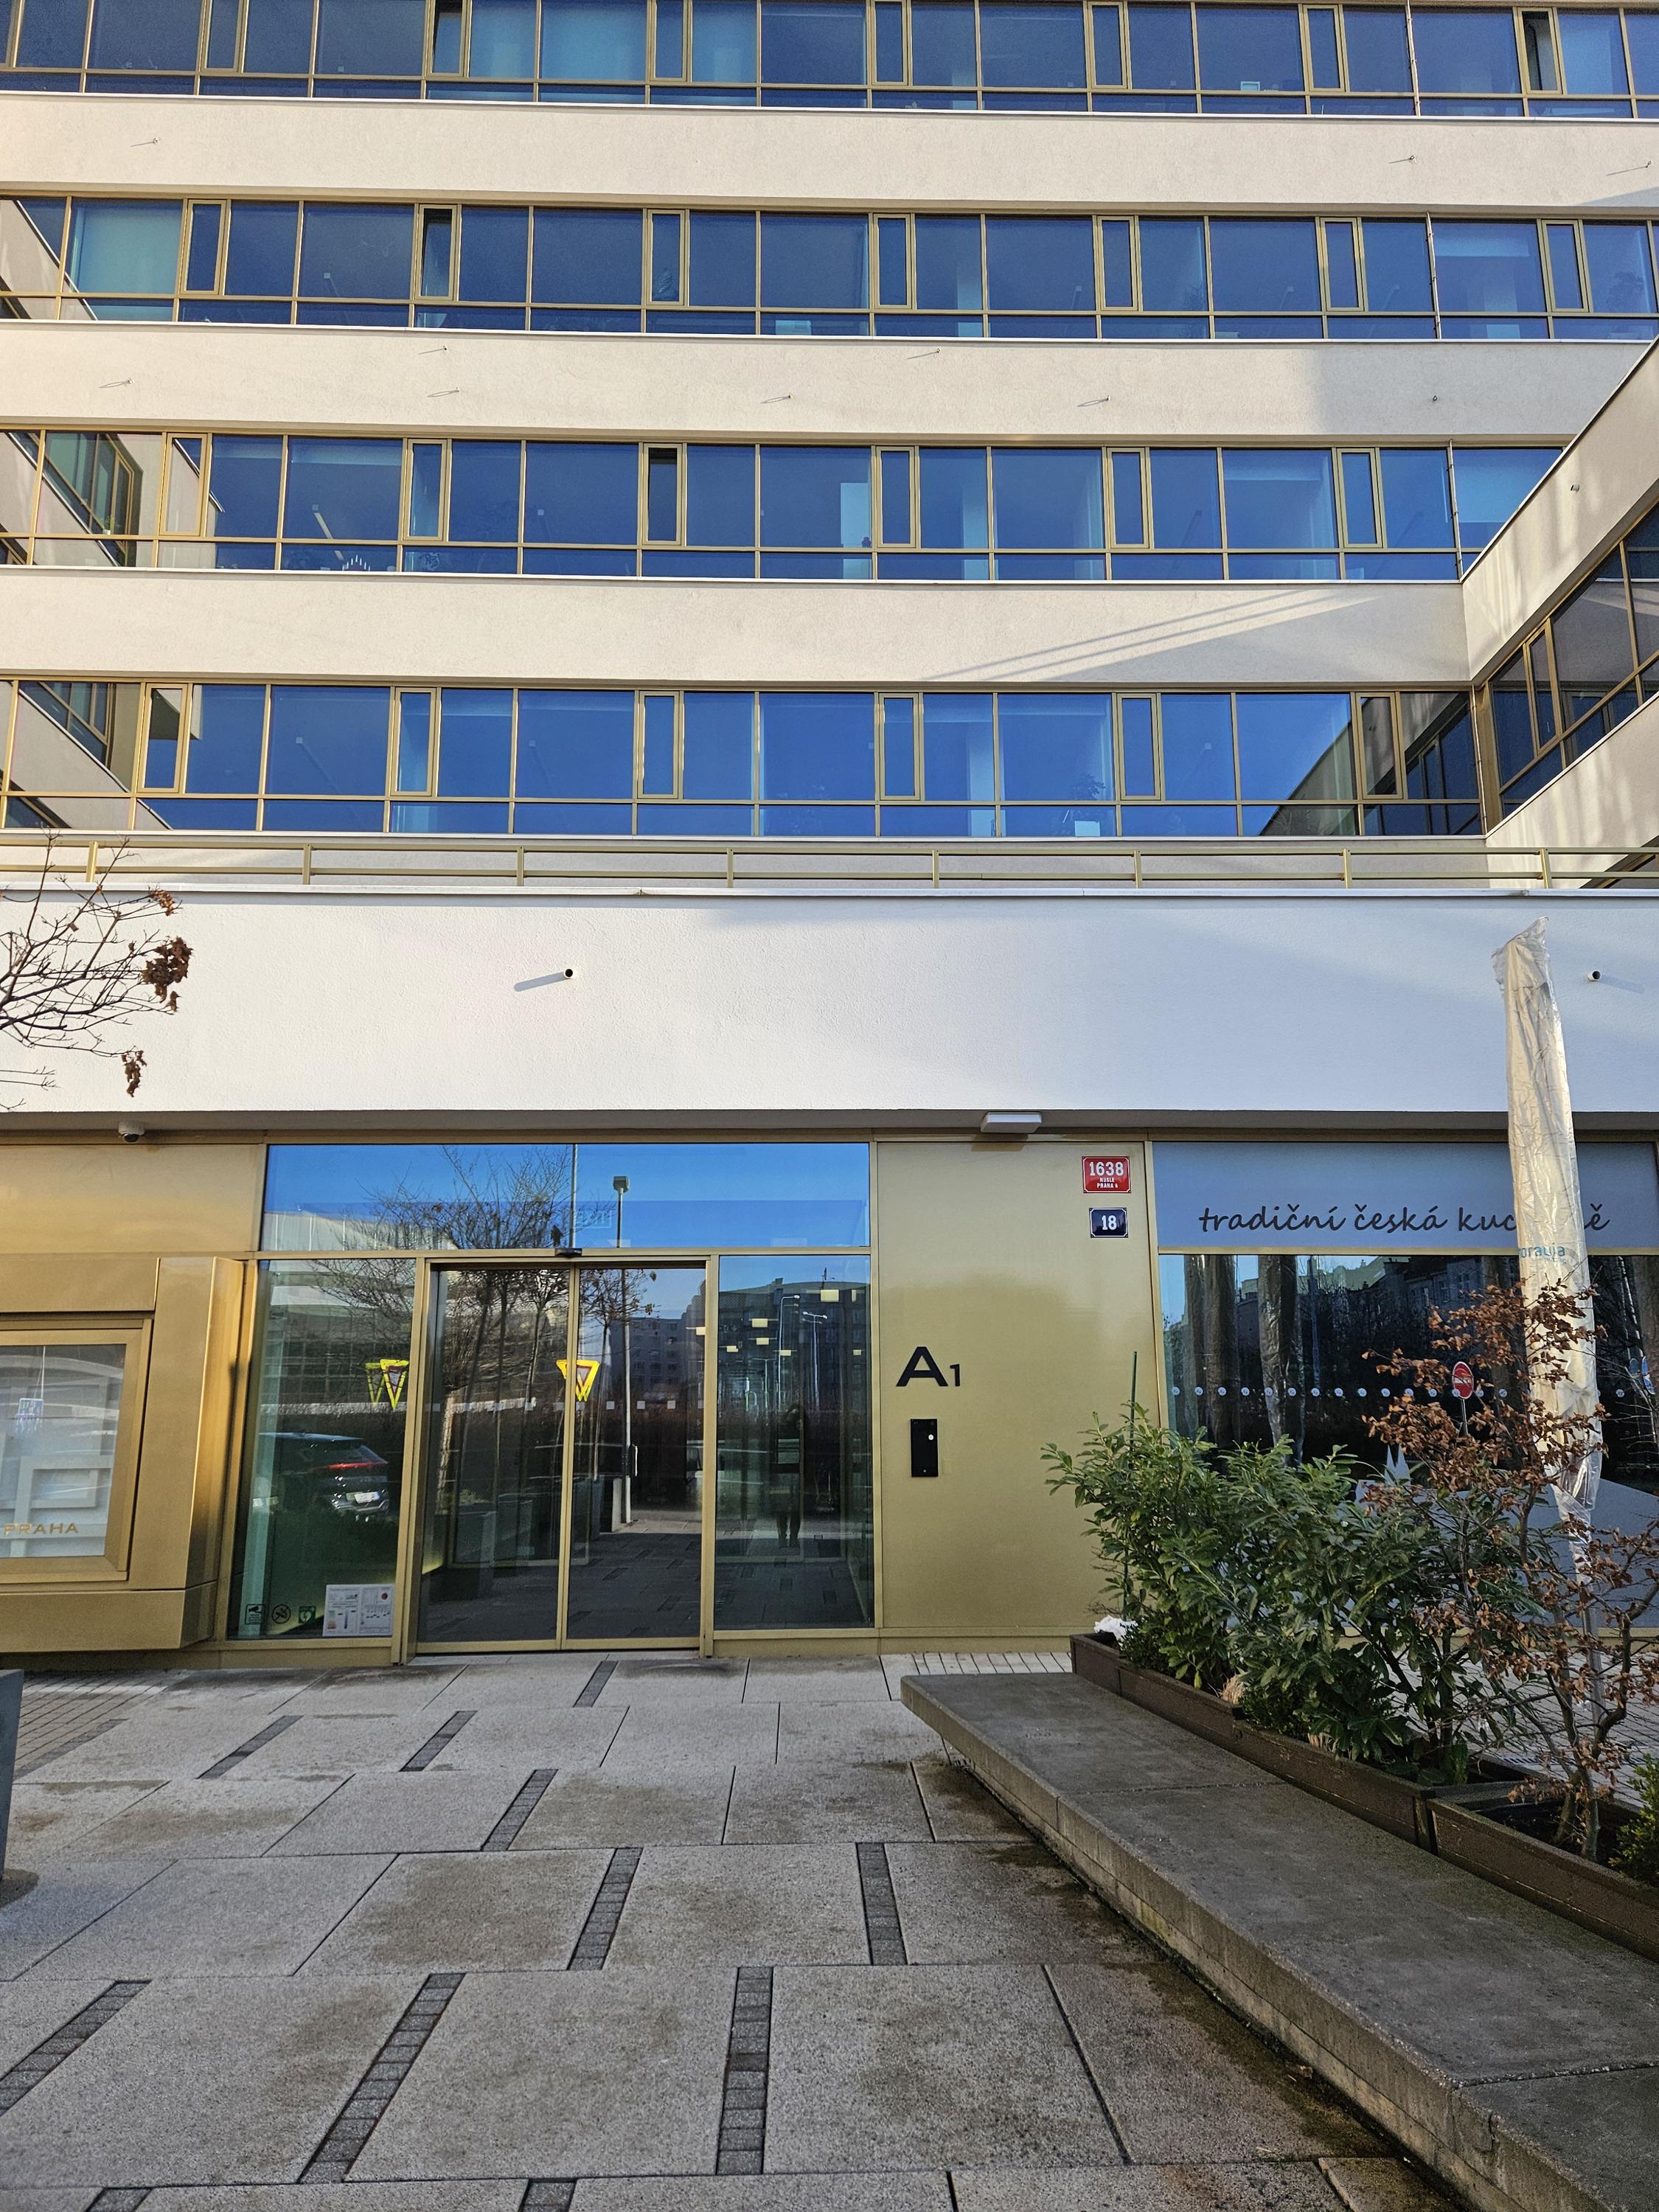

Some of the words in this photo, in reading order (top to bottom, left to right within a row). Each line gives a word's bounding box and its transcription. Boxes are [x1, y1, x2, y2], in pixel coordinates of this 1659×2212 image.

[1089, 1161, 1124, 1176] 1638
[1102, 1214, 1117, 1231] 18
[1199, 1203, 1346, 1232] tradiční
[1354, 1203, 1448, 1233] česká
[1458, 1203, 1610, 1231] kucě
[4, 1522, 79, 1535] PRAHA
